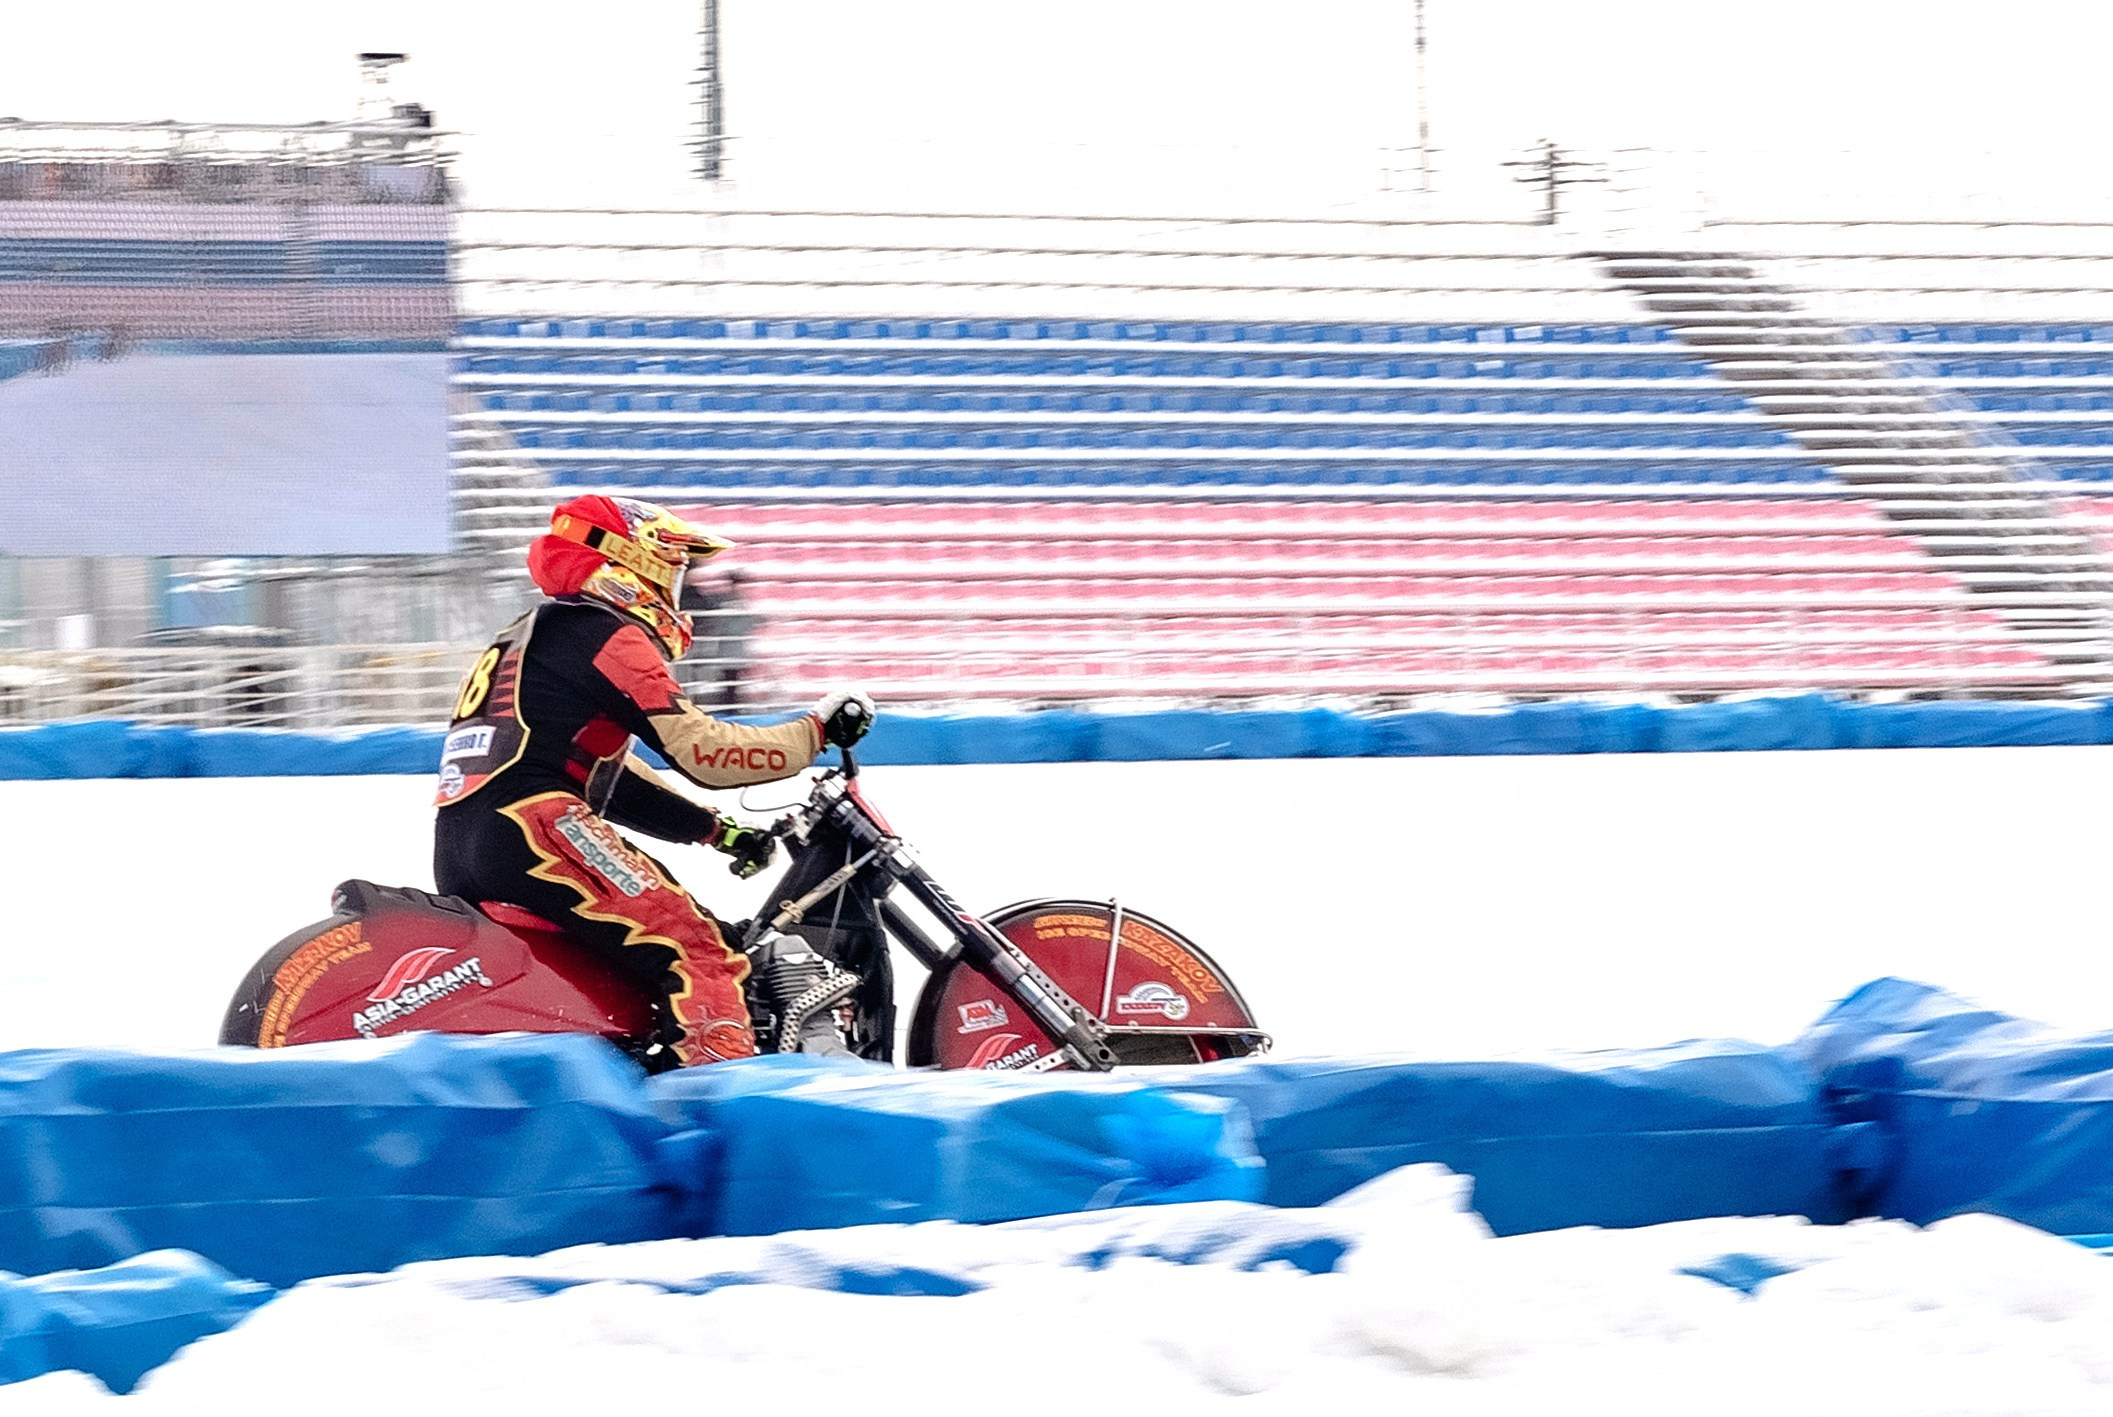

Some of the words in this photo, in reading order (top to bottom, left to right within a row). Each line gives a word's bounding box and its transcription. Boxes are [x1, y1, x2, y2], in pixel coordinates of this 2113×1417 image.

[606, 537, 668, 580] LEATT
[692, 743, 787, 771] WACO
[352, 957, 481, 1032] ASIA-GARANT
